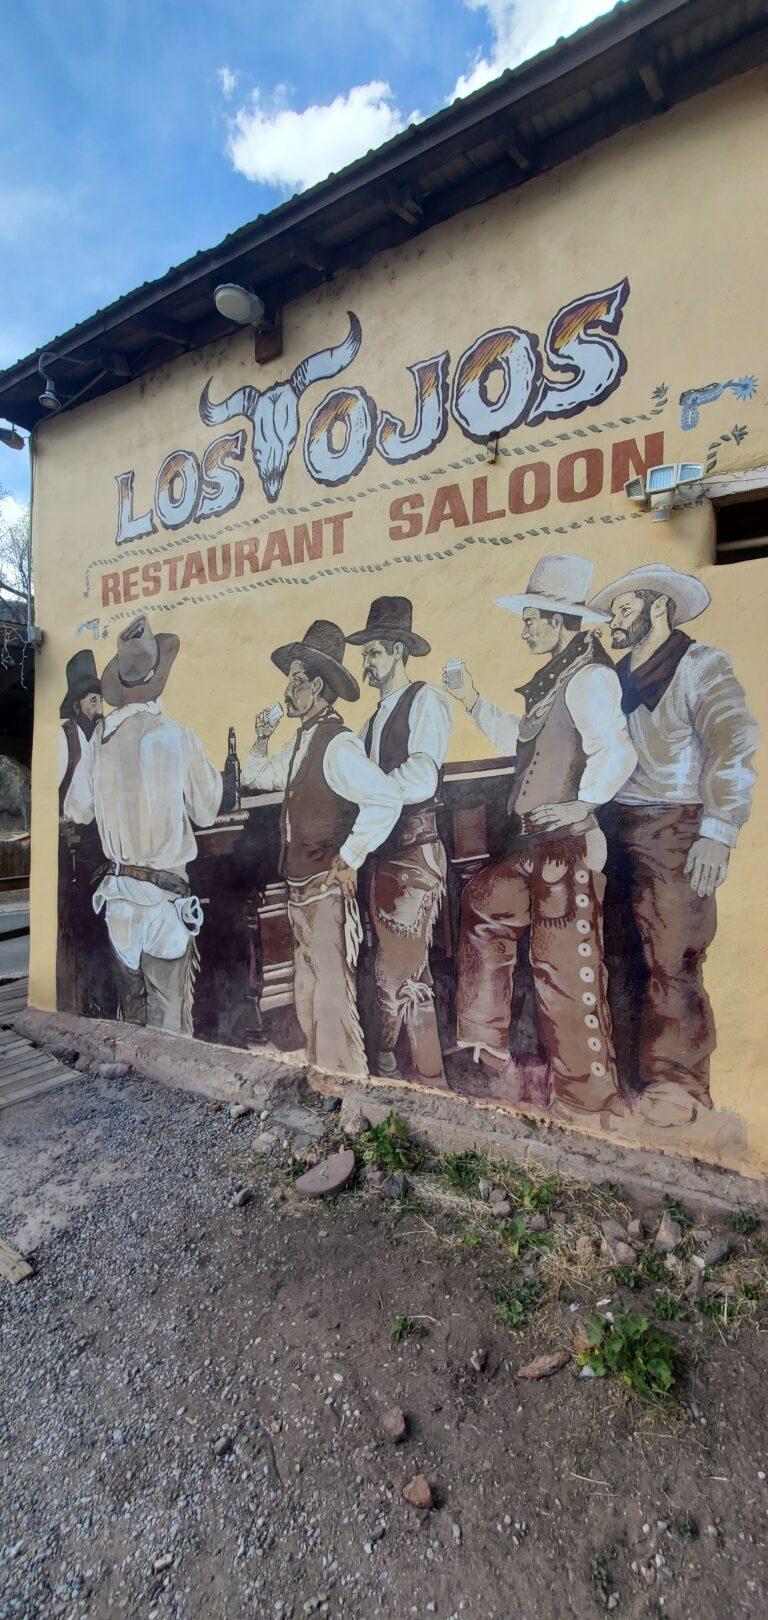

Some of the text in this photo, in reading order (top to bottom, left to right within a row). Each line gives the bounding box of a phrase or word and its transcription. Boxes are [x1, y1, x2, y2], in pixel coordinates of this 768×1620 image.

[101, 431, 664, 607] RESTAURANT SALOON
[115, 276, 630, 546] LOS OJOS
